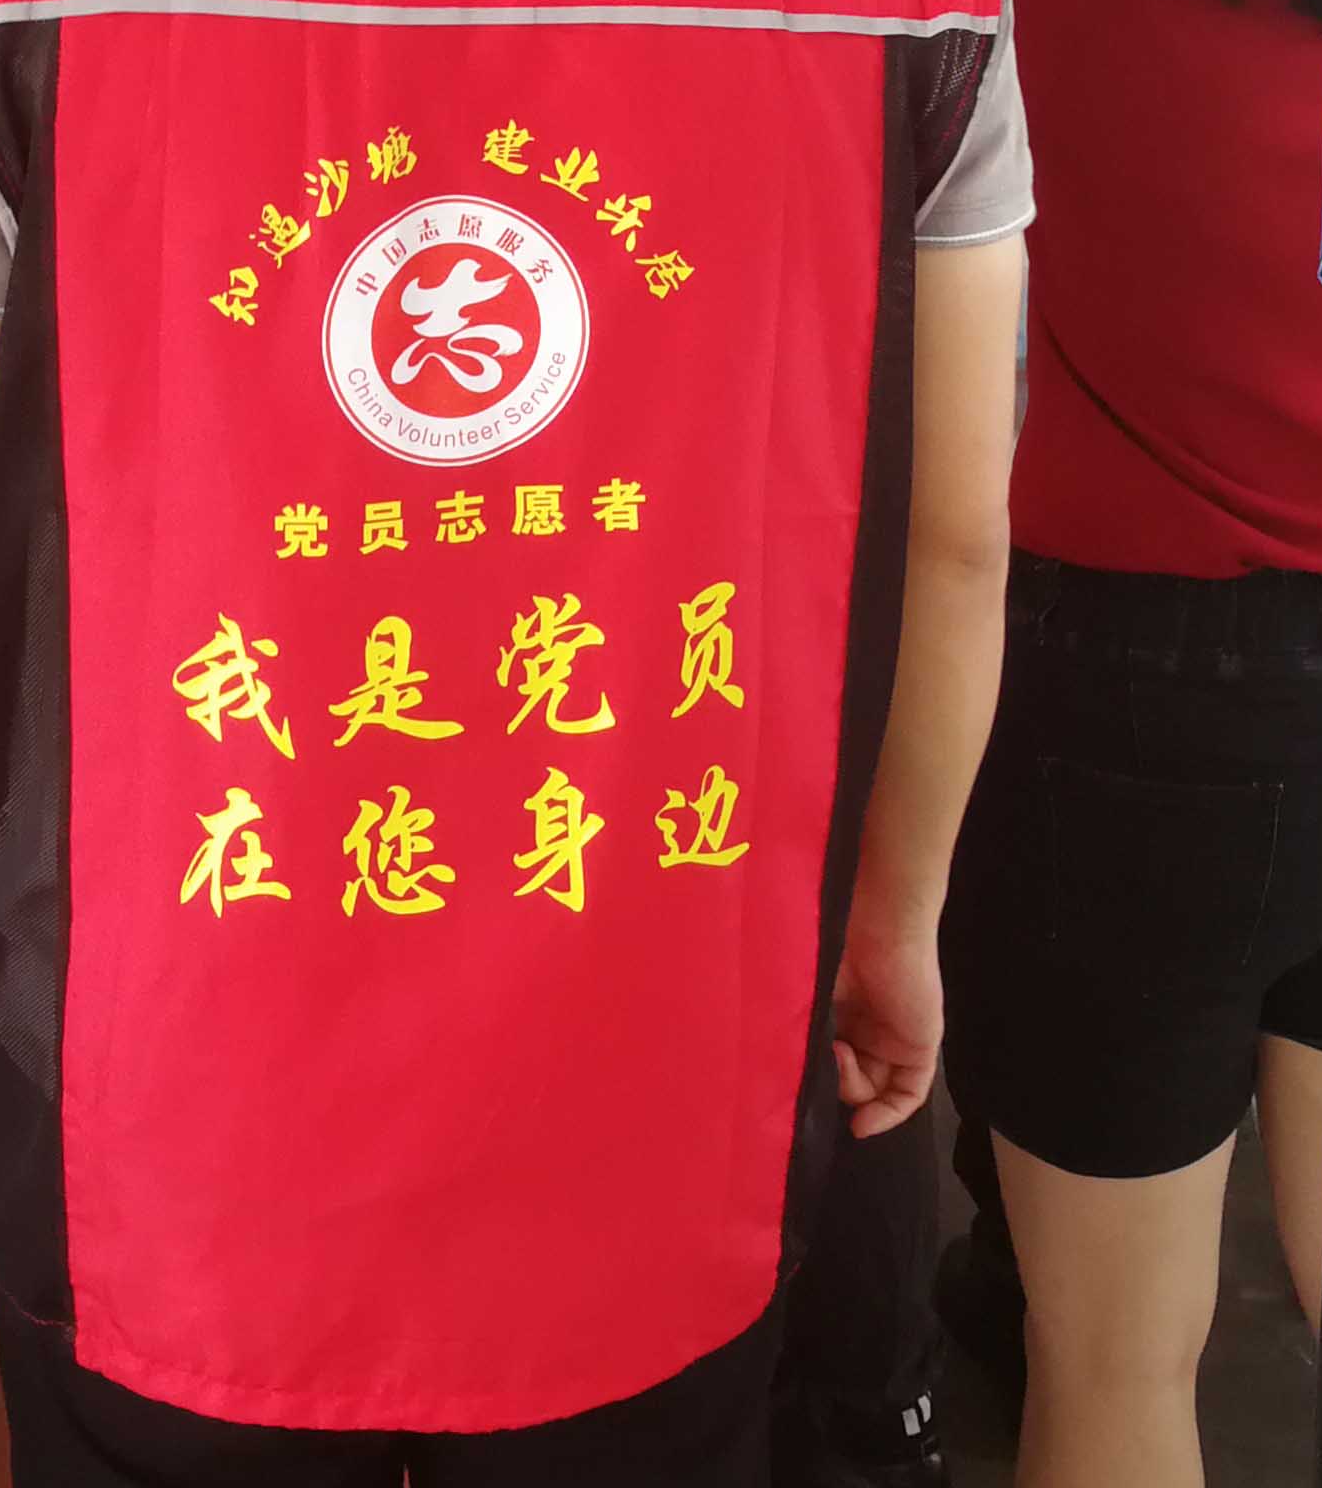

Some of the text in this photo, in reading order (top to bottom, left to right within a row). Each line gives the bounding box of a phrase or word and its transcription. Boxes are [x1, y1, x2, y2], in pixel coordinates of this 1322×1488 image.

[355, 213, 553, 296] 中国志愿服务
[348, 350, 567, 448] China Volunteer Service
[274, 478, 647, 559] 党员志愿者
[172, 581, 744, 759] 我是党员
[180, 764, 750, 919] 在您身边
